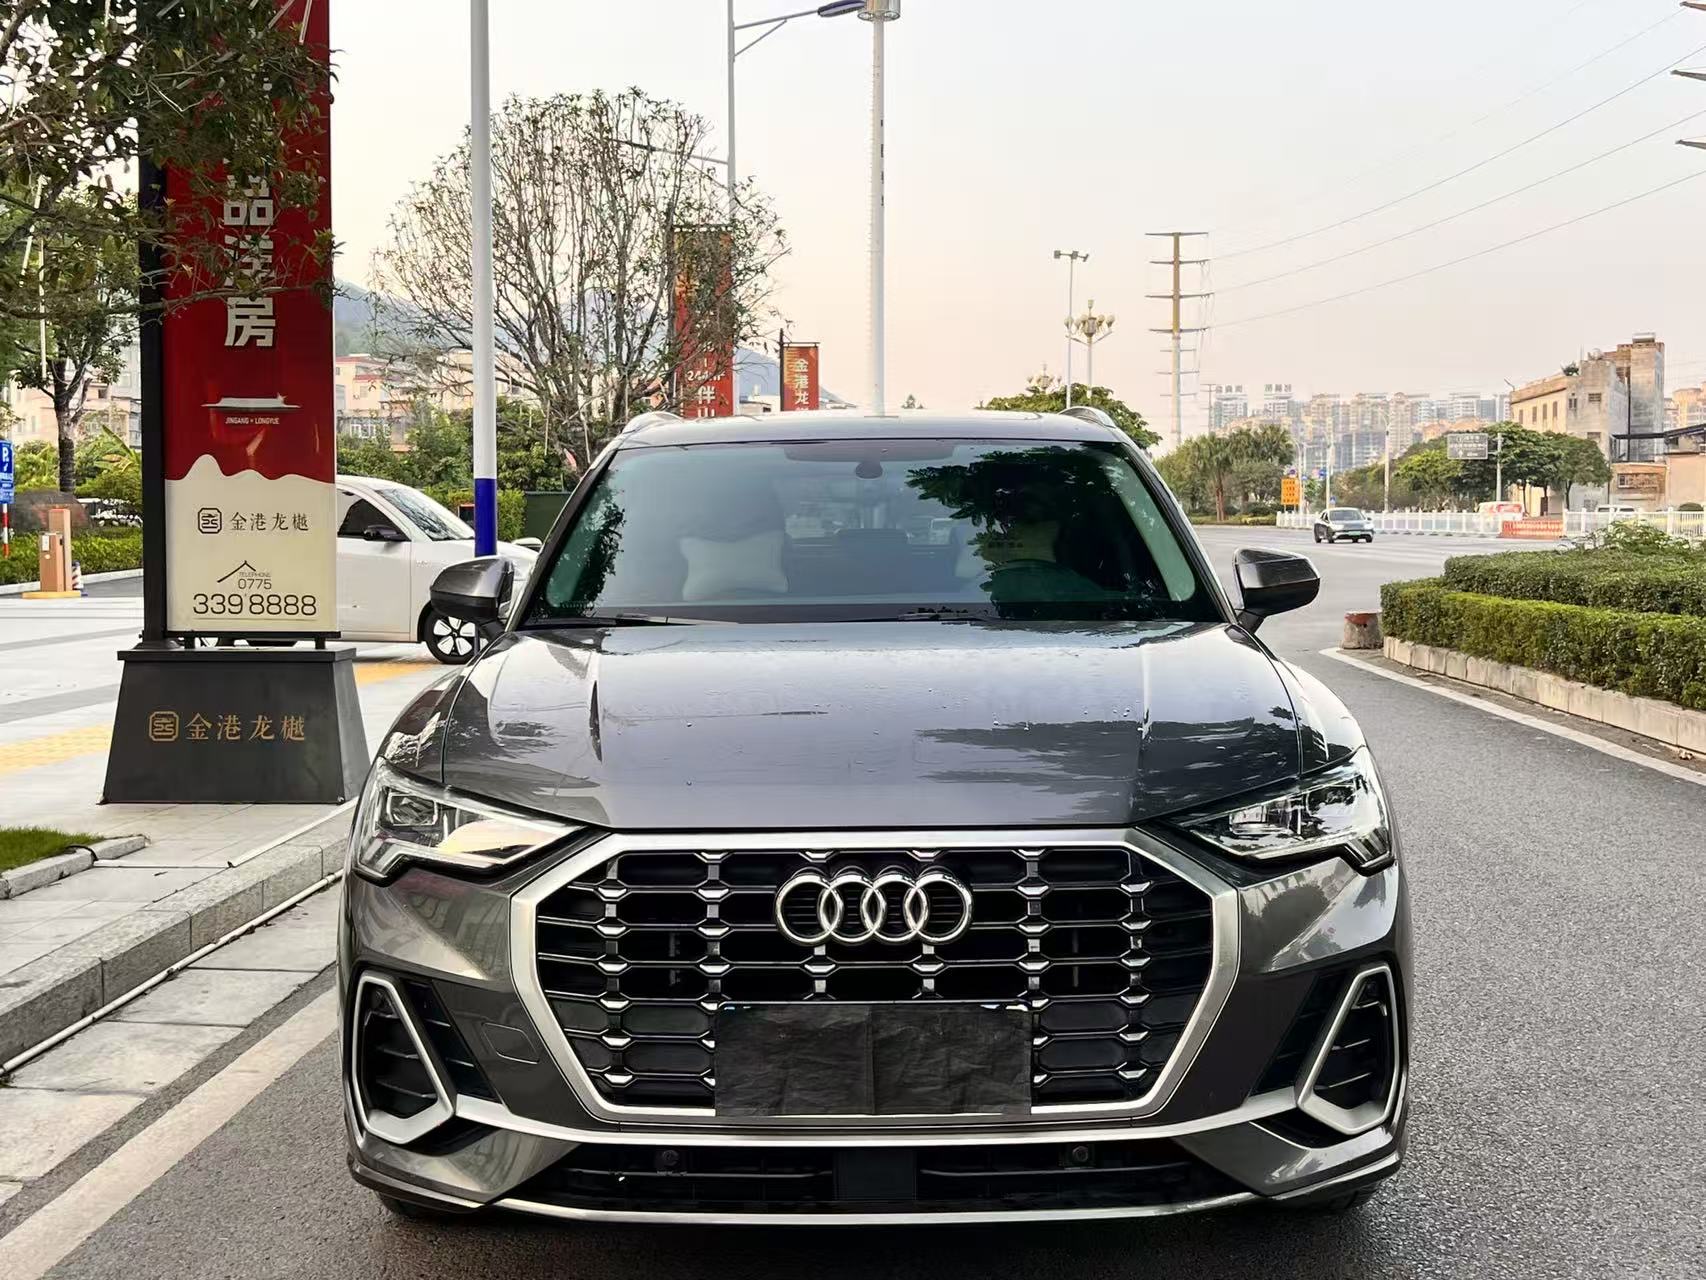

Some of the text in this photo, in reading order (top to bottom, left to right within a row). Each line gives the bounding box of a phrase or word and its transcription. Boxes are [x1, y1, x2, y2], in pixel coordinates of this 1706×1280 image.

[230, 511, 309, 531] 金港龙樾
[237, 578, 272, 590] 0775
[184, 712, 305, 741] 金港龙樾
